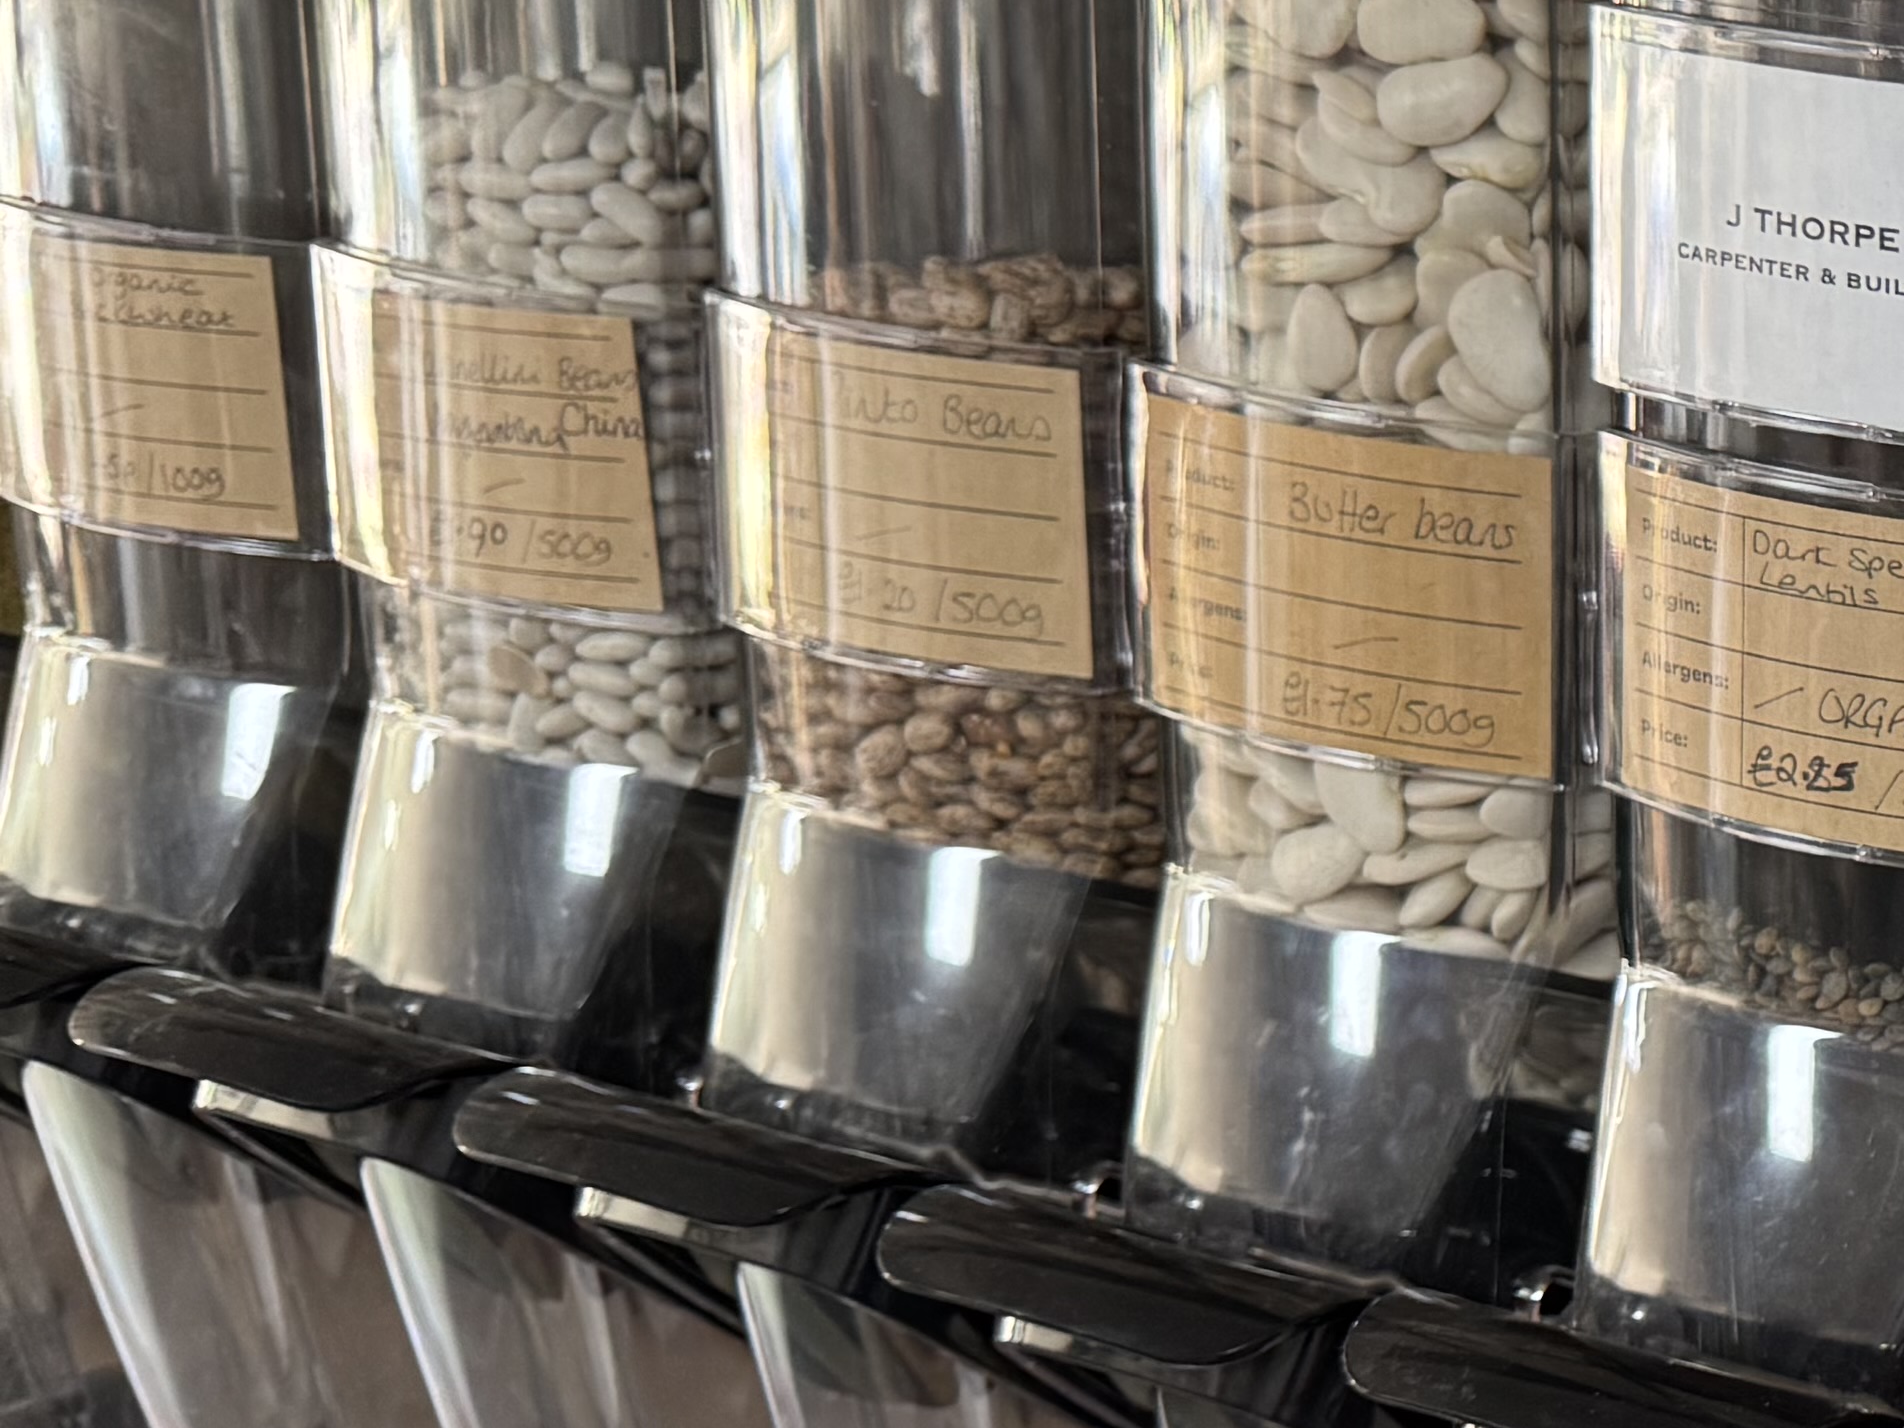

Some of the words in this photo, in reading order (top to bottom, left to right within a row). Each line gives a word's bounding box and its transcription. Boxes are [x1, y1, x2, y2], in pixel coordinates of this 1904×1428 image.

[1726, 204, 1742, 228] J
[1753, 207, 1900, 253] THORPE
[92, 267, 204, 301] Oganic
[1678, 242, 1810, 283] CARPENTER
[1821, 268, 1836, 286] &
[560, 401, 648, 440] China
[942, 393, 1053, 442] Beans
[1288, 482, 1396, 537] Butter
[1414, 497, 1516, 550] beans
[1753, 529, 1835, 567] Dark
[1760, 562, 1879, 606] Lentils
